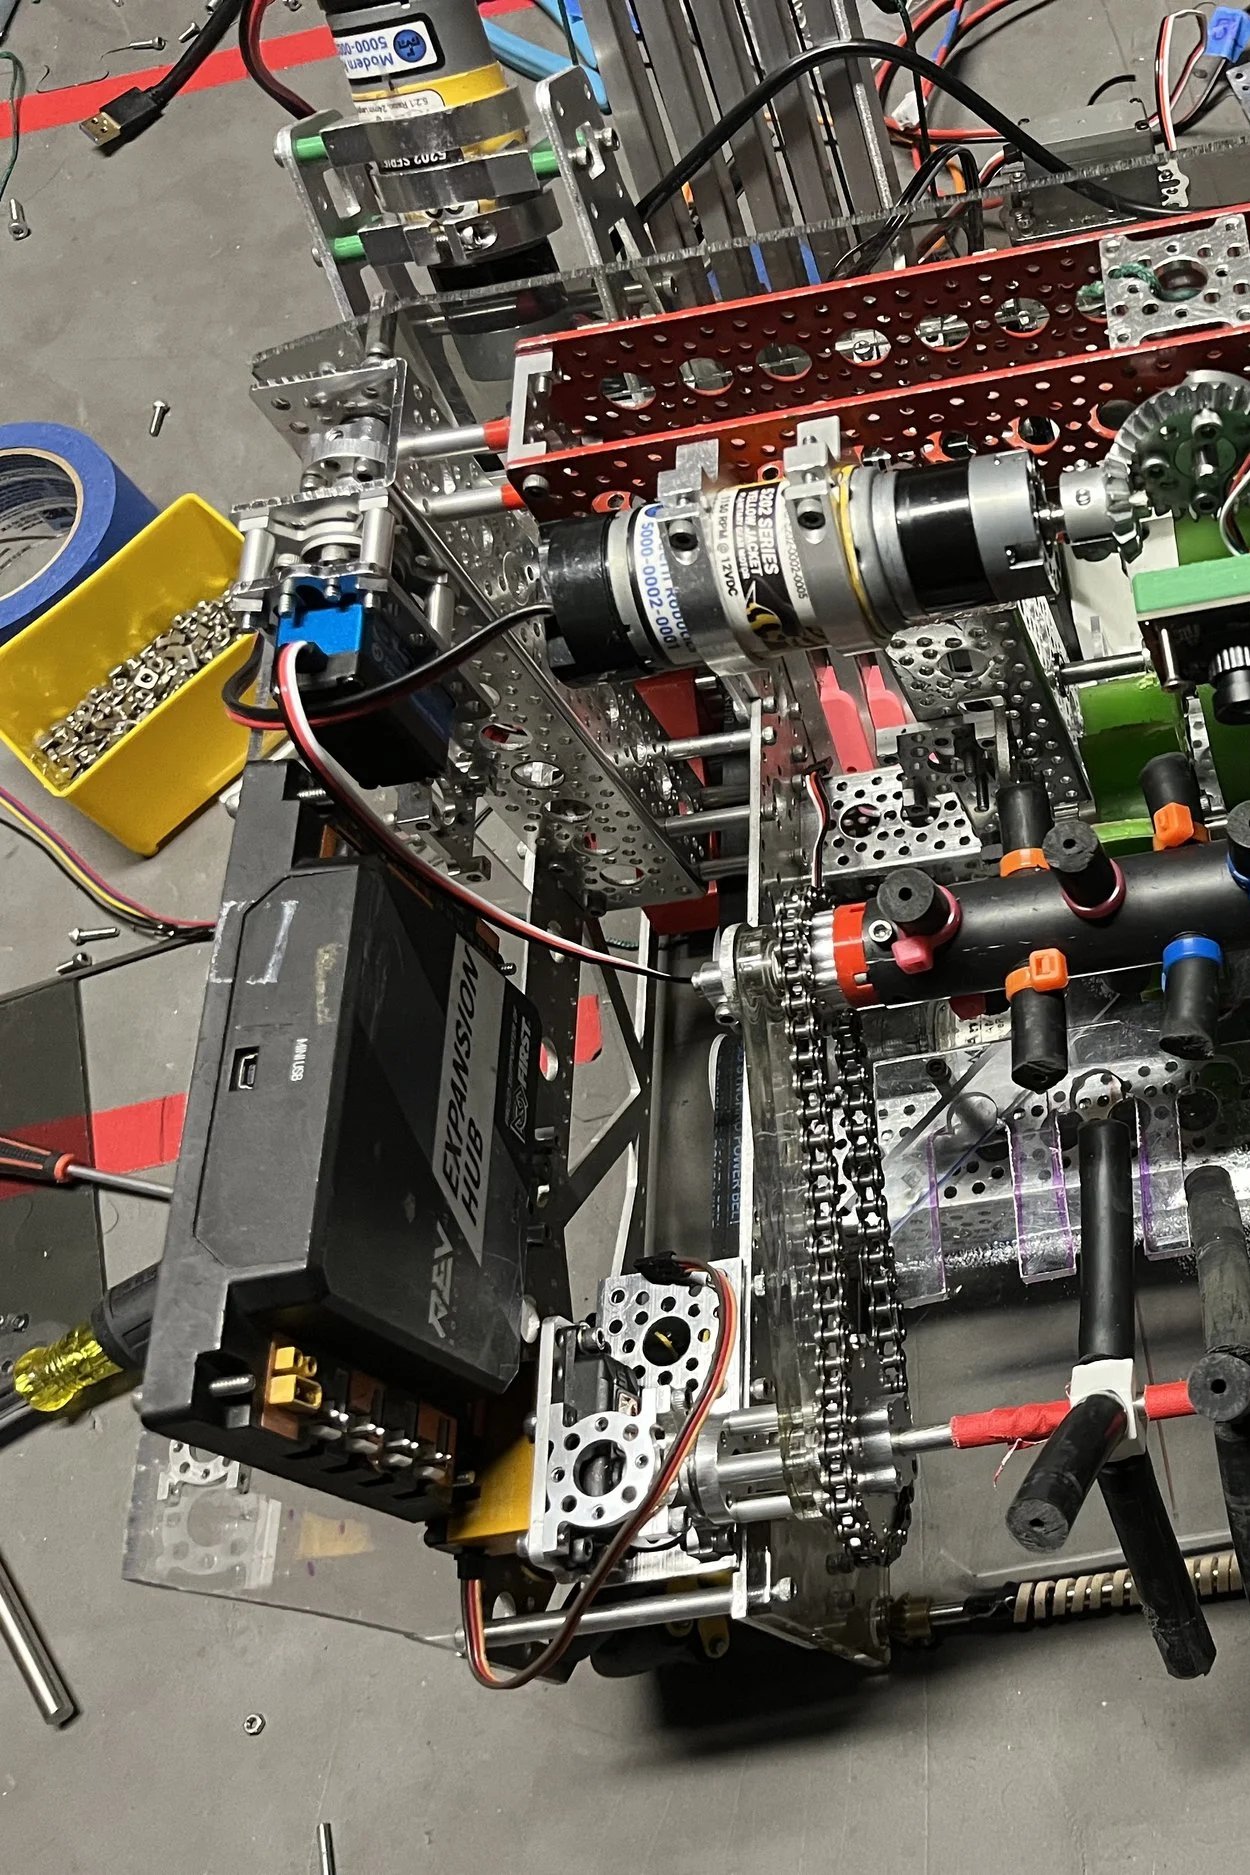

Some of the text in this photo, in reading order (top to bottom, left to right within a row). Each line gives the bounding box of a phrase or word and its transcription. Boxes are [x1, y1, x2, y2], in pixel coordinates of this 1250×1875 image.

[348, 52, 394, 71] Modern
[716, 542, 729, 554] @
[718, 516, 728, 539] RPM
[744, 490, 763, 577] YELLOW JACKET
[758, 488, 780, 576] 5202 SERIES
[640, 522, 681, 650] 5000-0002-0001
[721, 558, 739, 597] 12VDC
[738, 548, 751, 580] MOTOR
[290, 1038, 309, 1081] MINI USB
[442, 944, 480, 1200] EXPANSION
[517, 1016, 533, 1088] FIRST
[461, 1116, 483, 1227] HUB
[730, 1135, 743, 1191] POWER
[428, 1220, 454, 1339] REV
